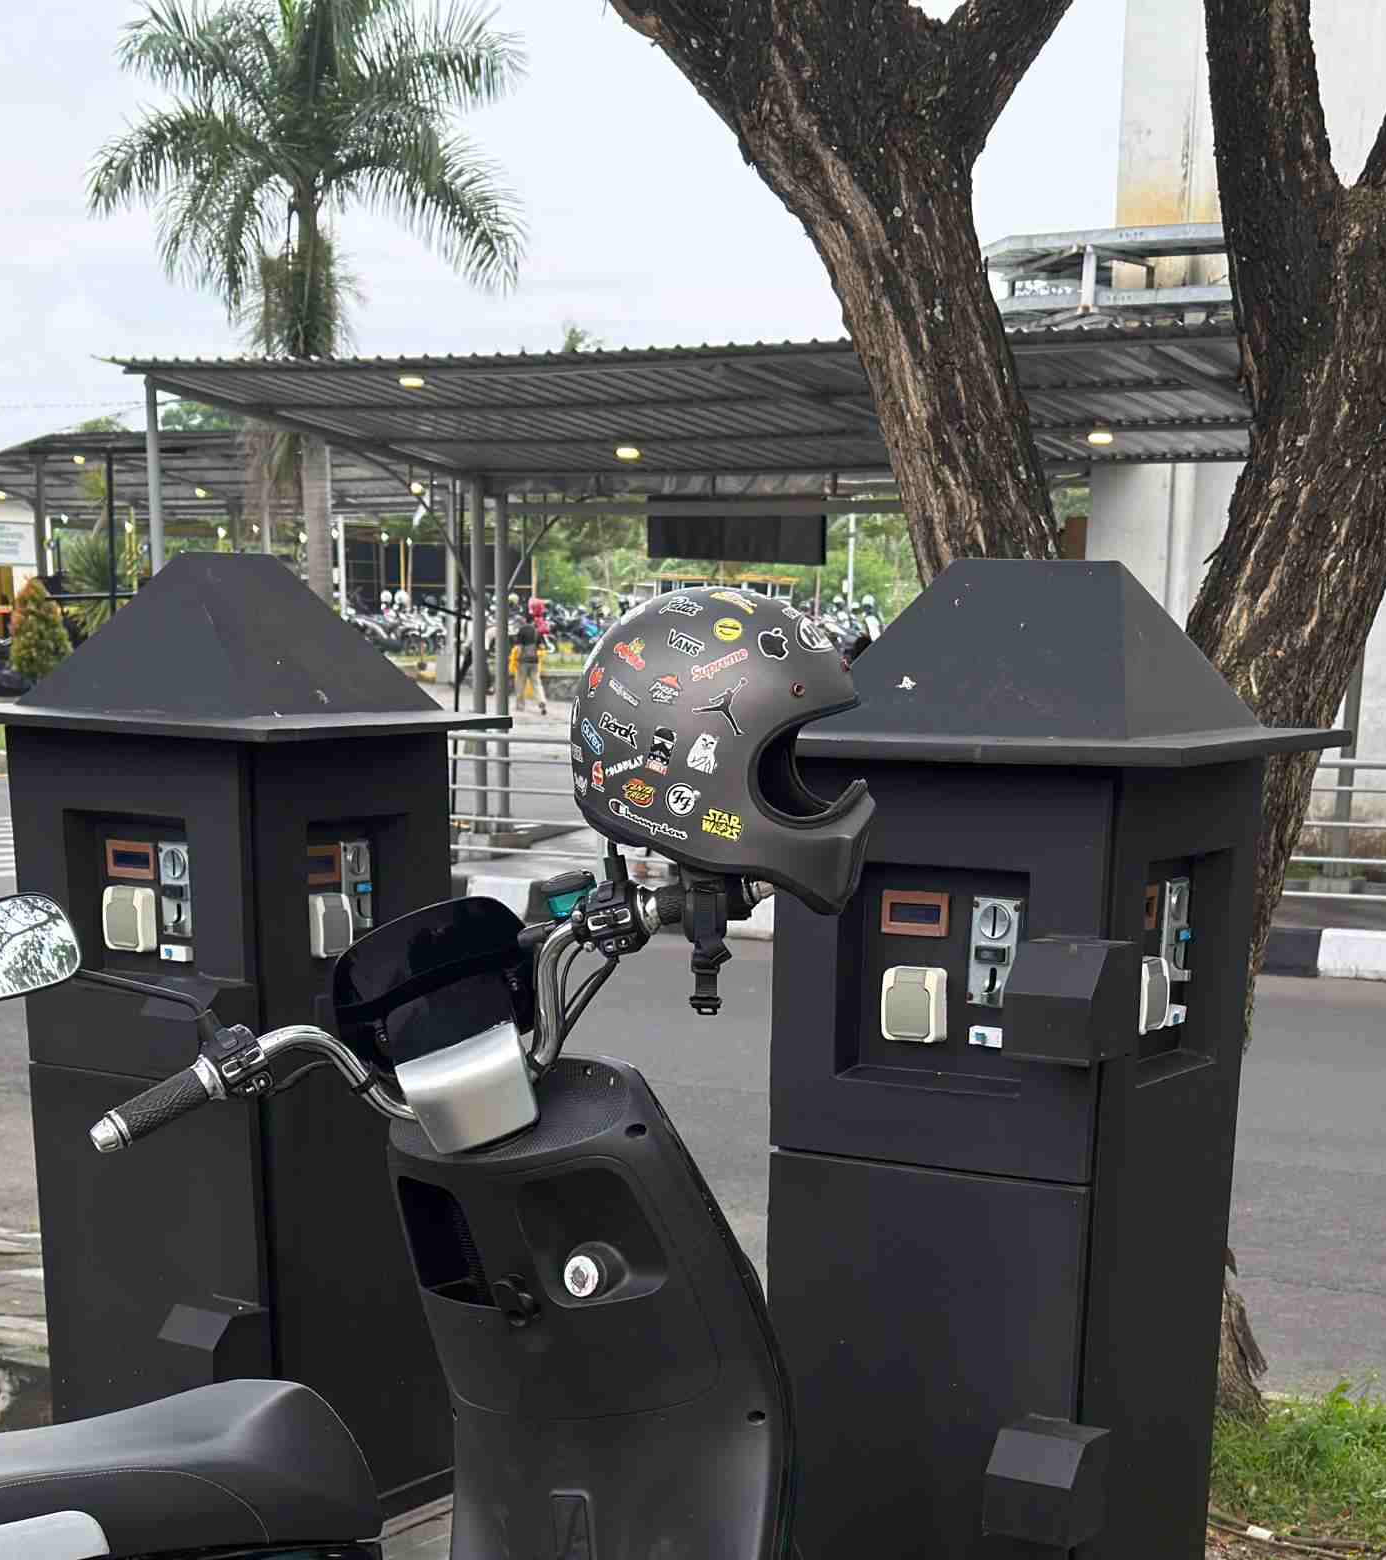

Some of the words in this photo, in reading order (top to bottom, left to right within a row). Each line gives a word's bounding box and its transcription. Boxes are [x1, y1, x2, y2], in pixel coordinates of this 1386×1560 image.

[667, 629, 705, 657] VANS
[582, 720, 603, 753] durex
[609, 799, 688, 841] Champion
[701, 819, 742, 841] WARS
[703, 809, 742, 829] STAR
